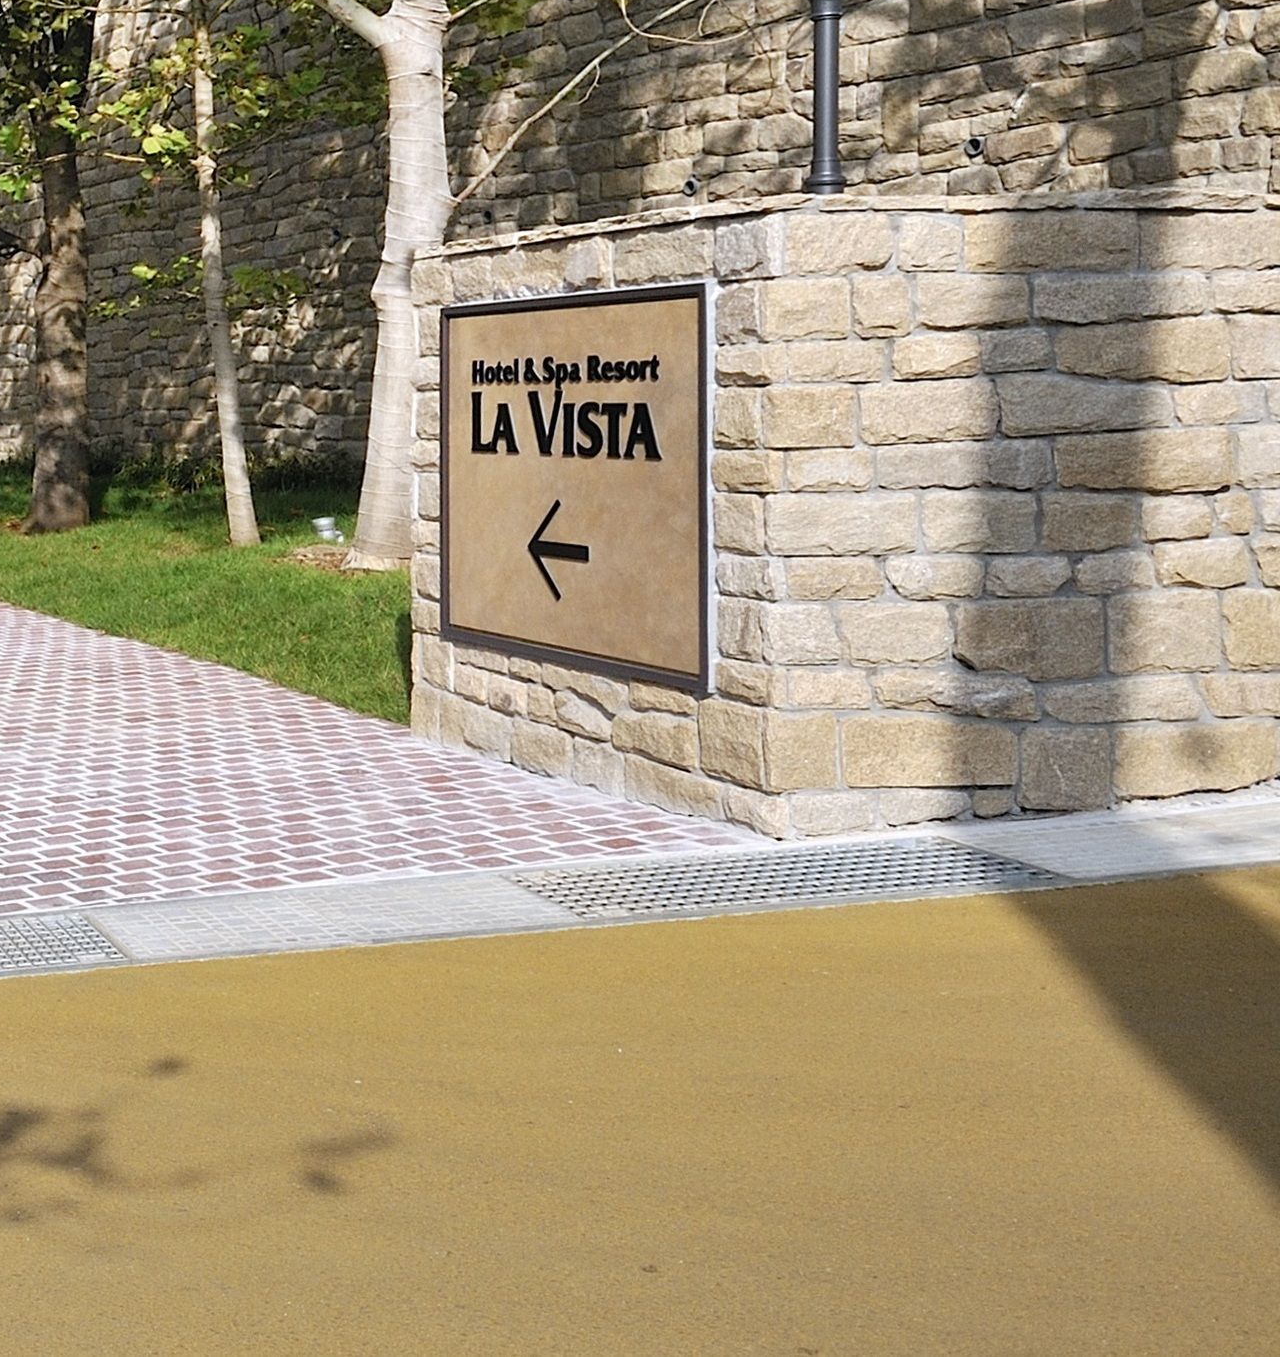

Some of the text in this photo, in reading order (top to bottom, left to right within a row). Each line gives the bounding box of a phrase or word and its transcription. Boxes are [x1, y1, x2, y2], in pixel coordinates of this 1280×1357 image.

[472, 355, 660, 390] Hotel & Spa Resort
[471, 390, 662, 461] LA VISTA
